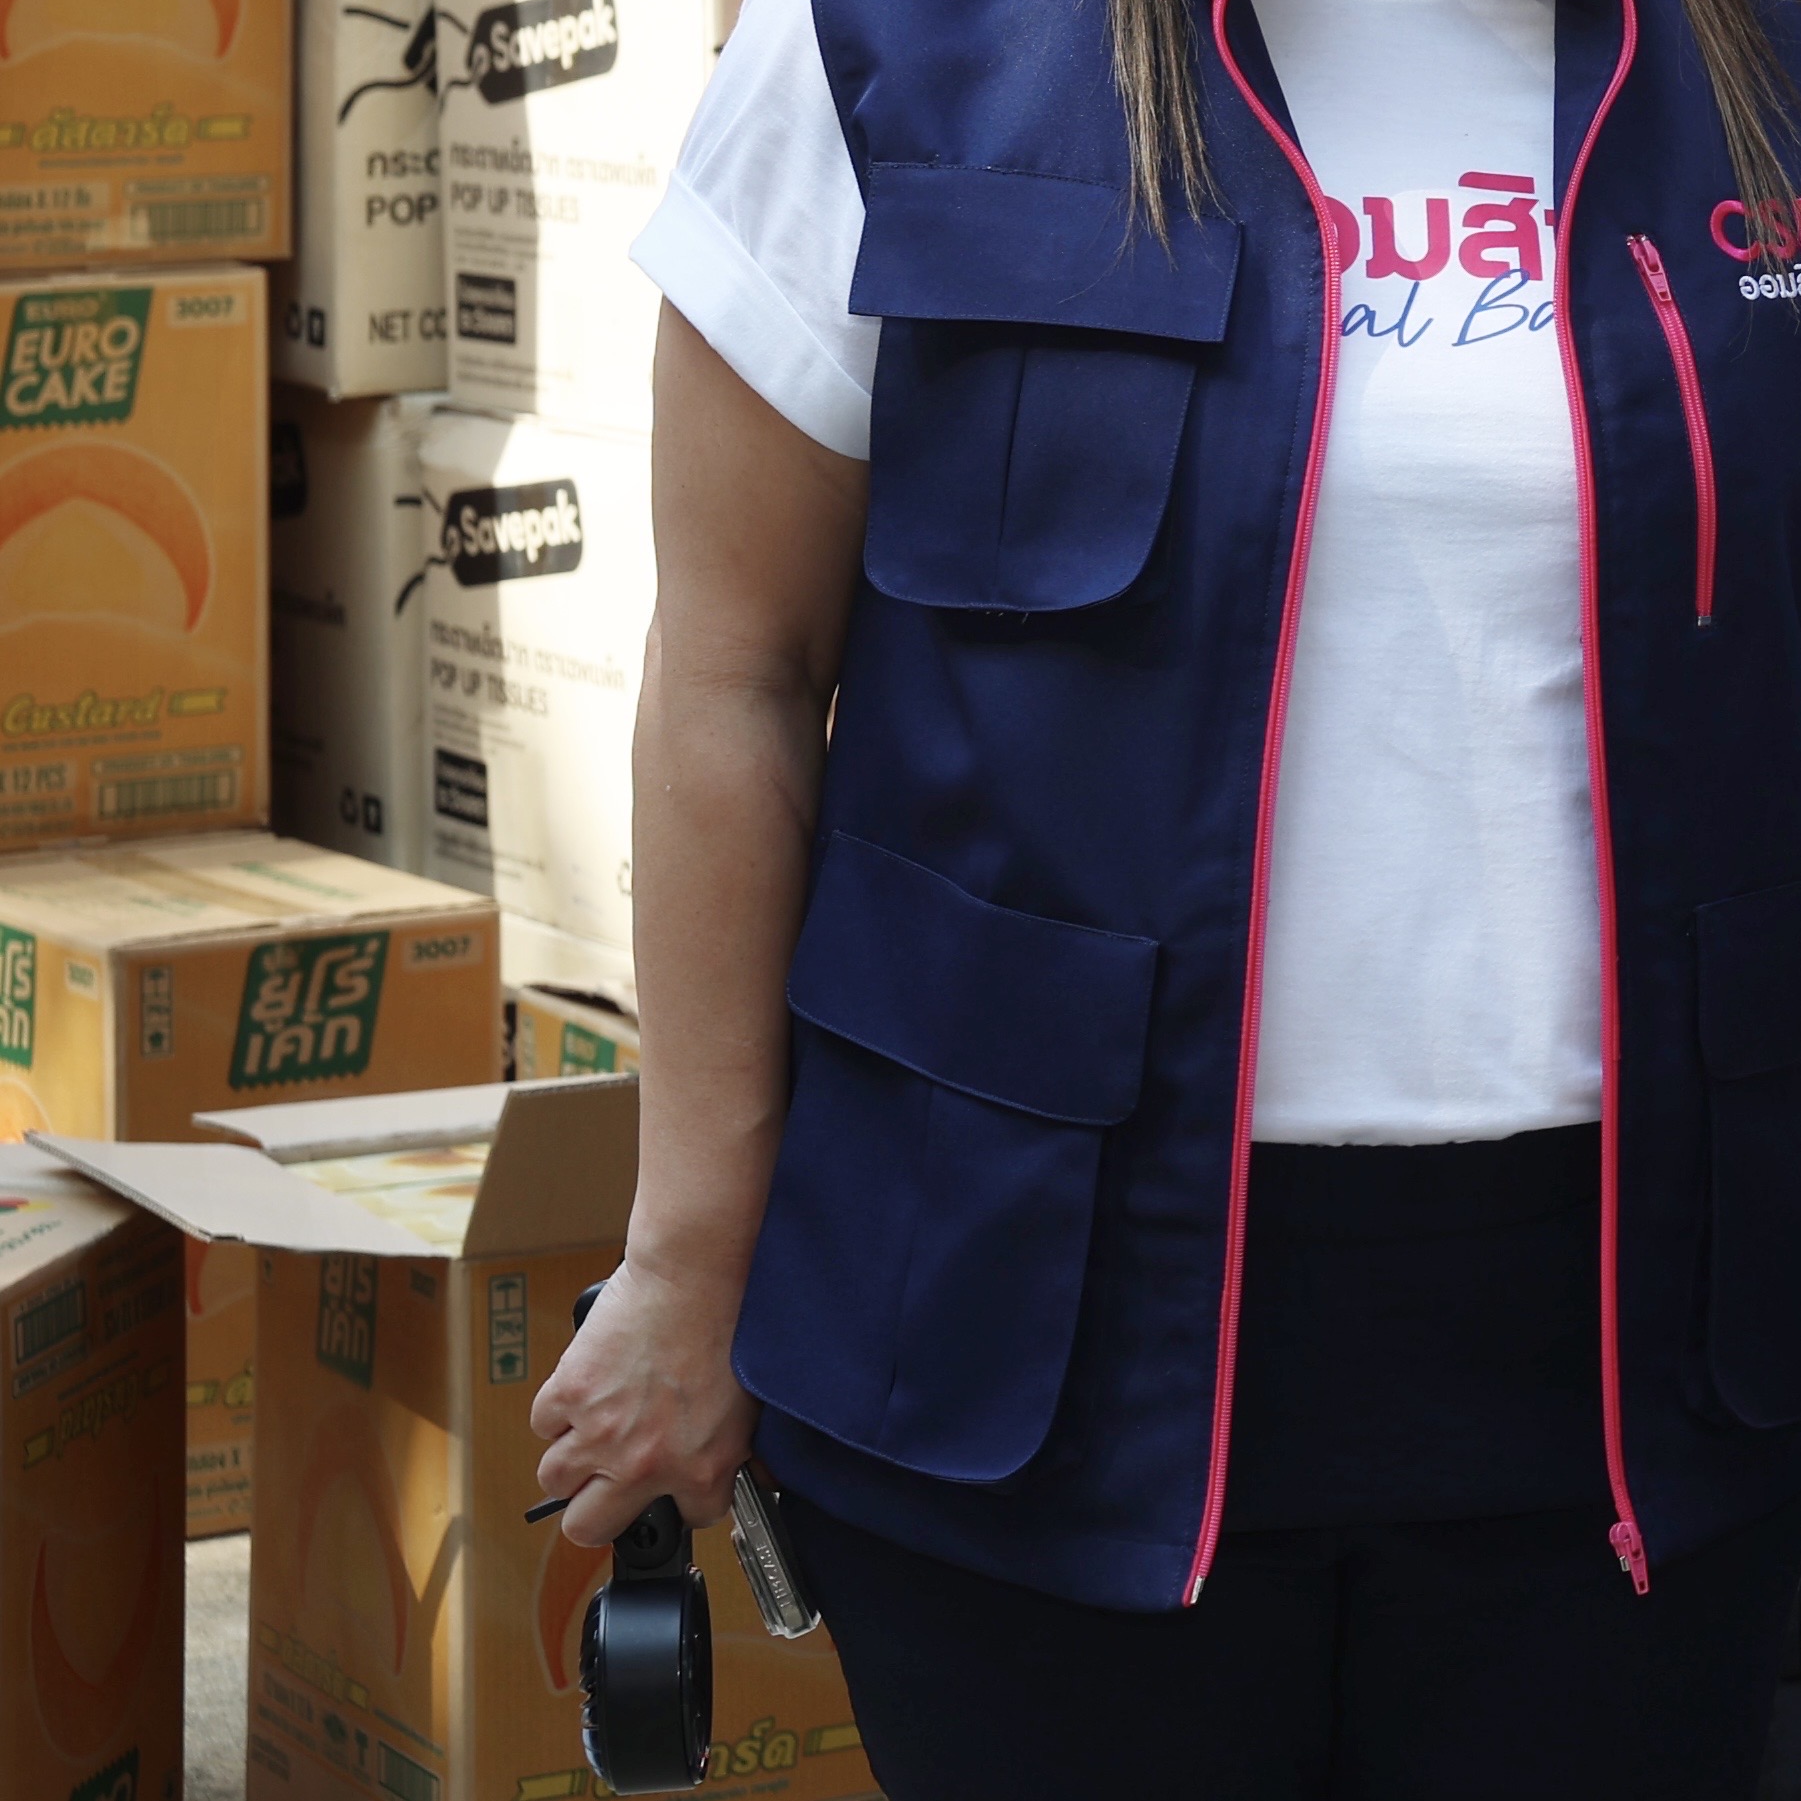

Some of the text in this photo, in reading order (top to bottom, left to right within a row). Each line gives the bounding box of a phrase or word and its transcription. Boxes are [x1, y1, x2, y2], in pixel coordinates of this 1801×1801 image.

[366, 193, 440, 228] POP
[1321, 171, 1556, 281] มสิ
[176, 295, 234, 318] 3007
[369, 309, 412, 343] NET
[12, 316, 140, 373] EURO
[5, 360, 133, 417] CAKE
[459, 490, 580, 561] Savepak
[3, 688, 164, 736] Custard
[411, 937, 472, 964] 3007
